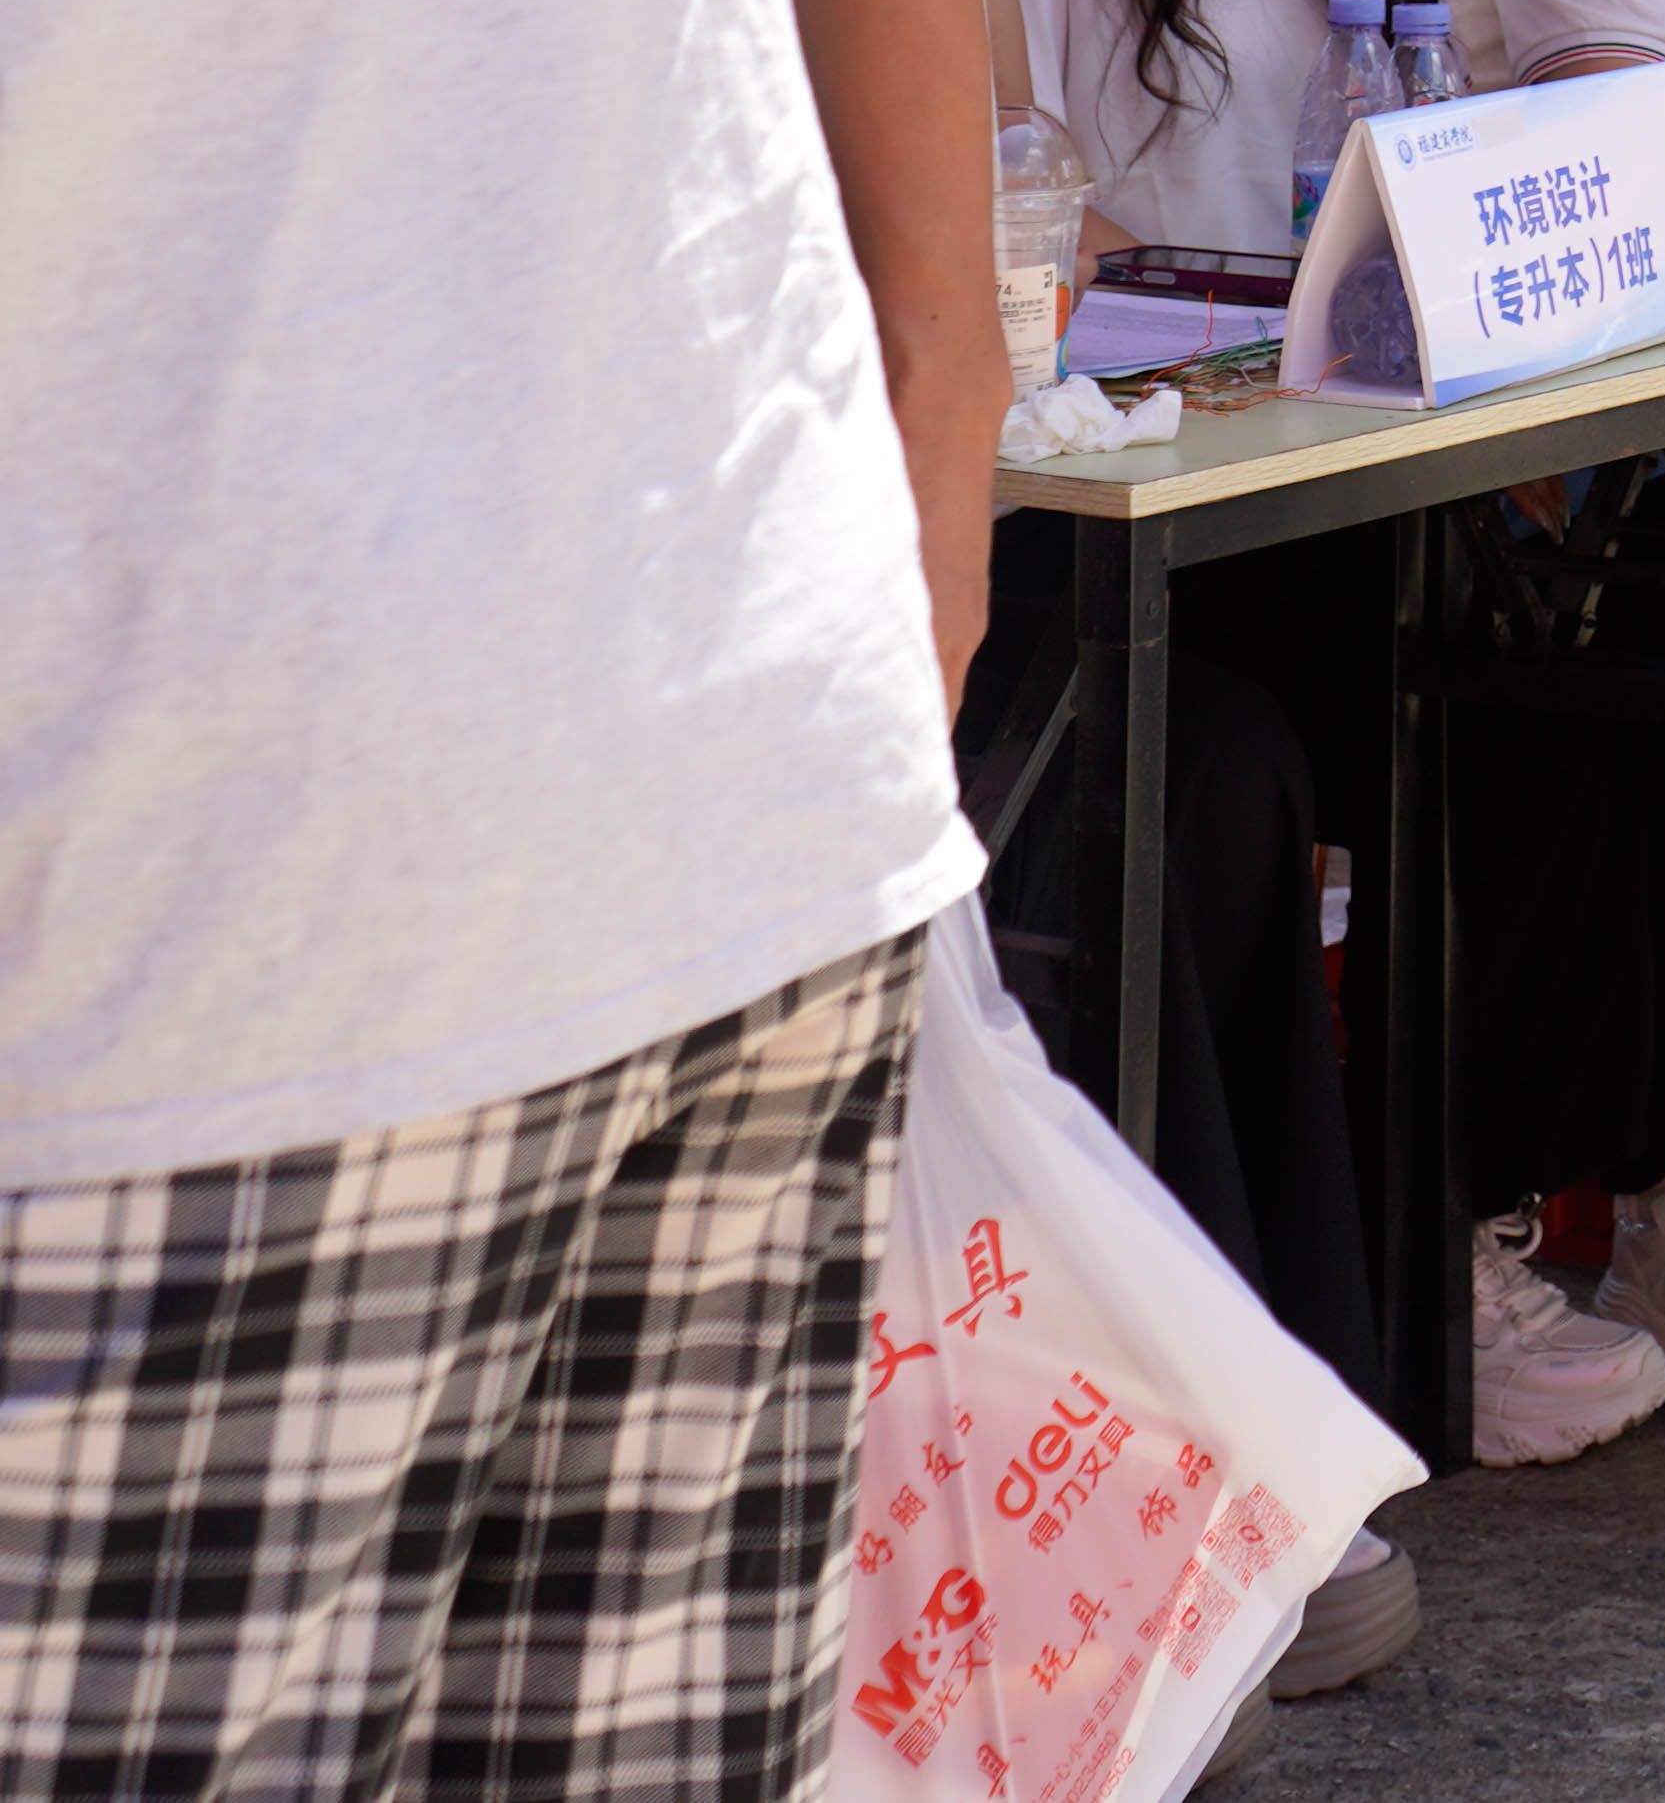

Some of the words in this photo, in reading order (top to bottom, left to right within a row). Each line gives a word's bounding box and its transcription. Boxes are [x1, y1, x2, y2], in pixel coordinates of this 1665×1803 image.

[1473, 155, 1612, 247] 环境设计
[1474, 226, 1659, 339] (专升本)1班
[994, 1370, 1112, 1522] deli
[1027, 1413, 1136, 1555] 得力文具
[852, 1567, 986, 1740] M&G
